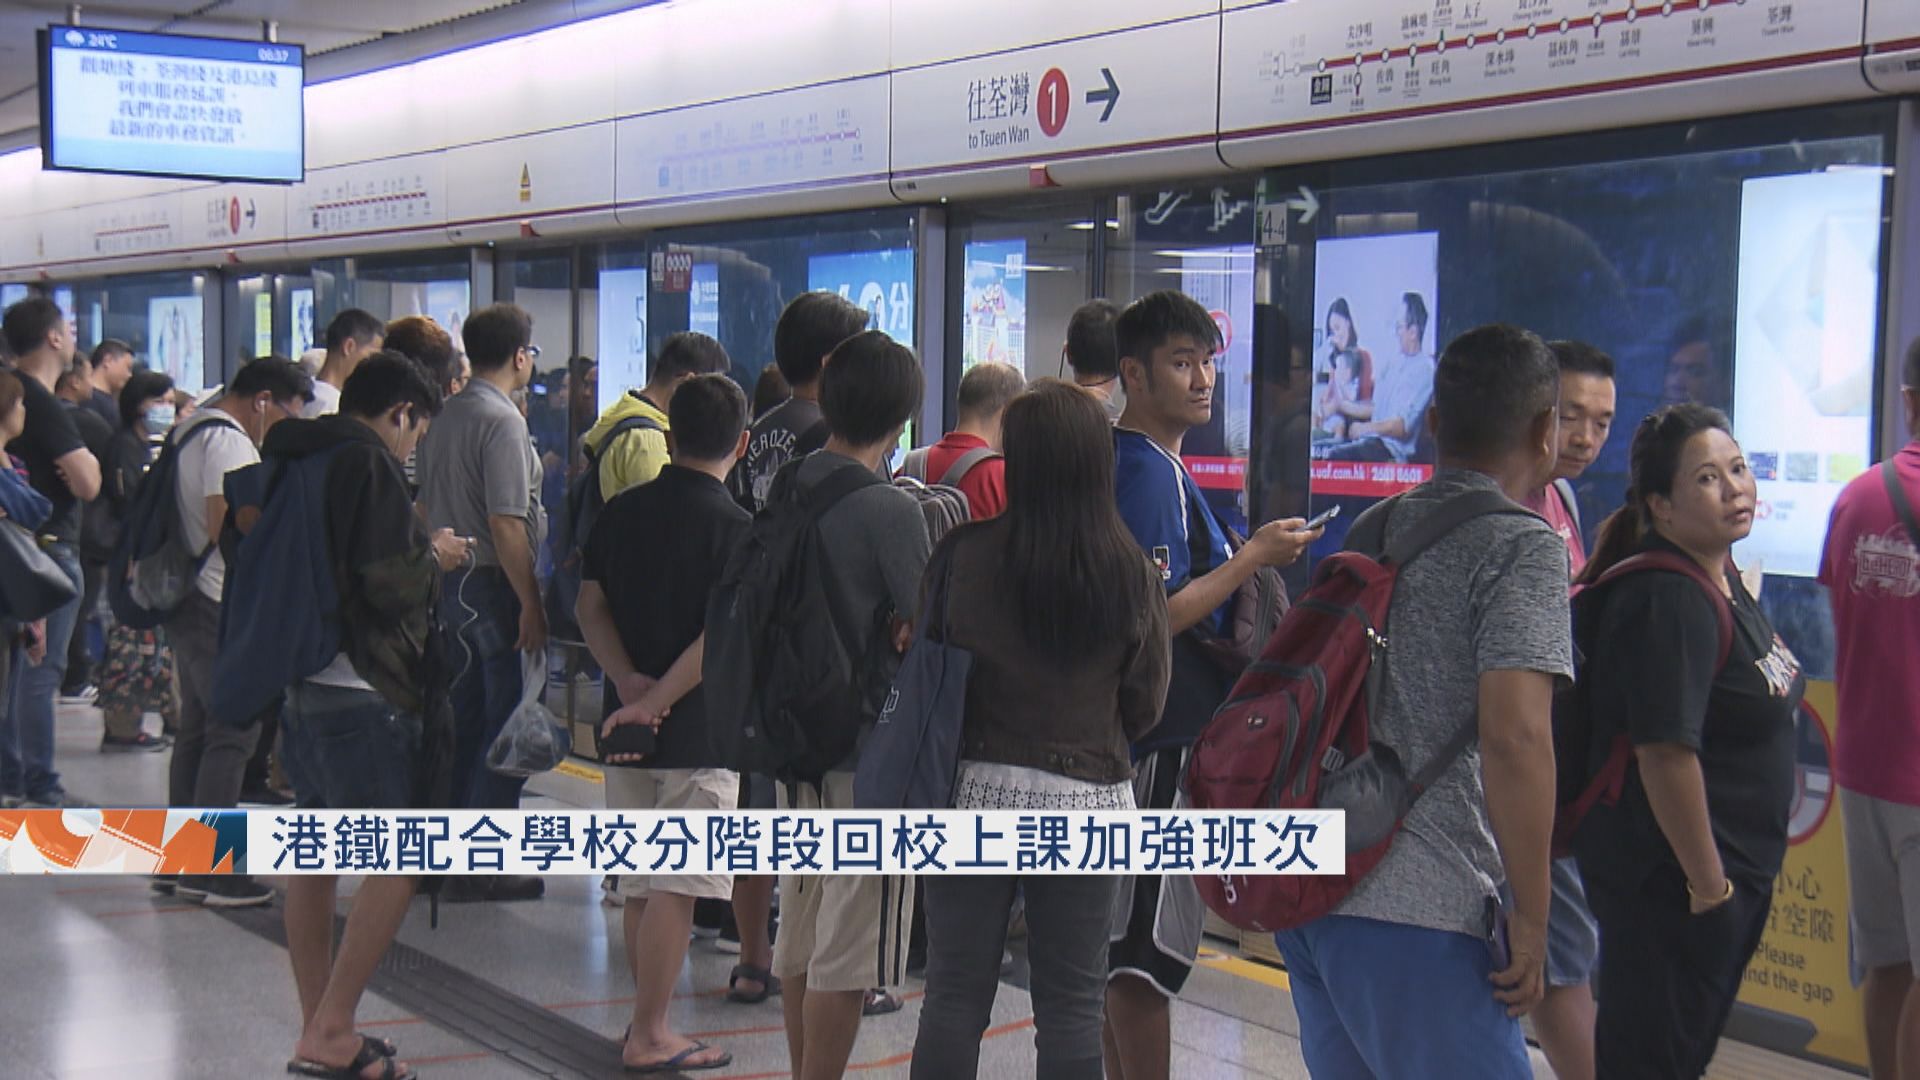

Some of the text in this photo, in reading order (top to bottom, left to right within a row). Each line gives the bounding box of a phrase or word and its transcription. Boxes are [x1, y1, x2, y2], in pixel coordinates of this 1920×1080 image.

[968, 72, 1030, 123] 往荃灣
[1048, 82, 1057, 127] 1
[968, 125, 1030, 149] to Tsuen Wan
[1772, 968, 1799, 994] the
[1801, 979, 1834, 1006] gap
